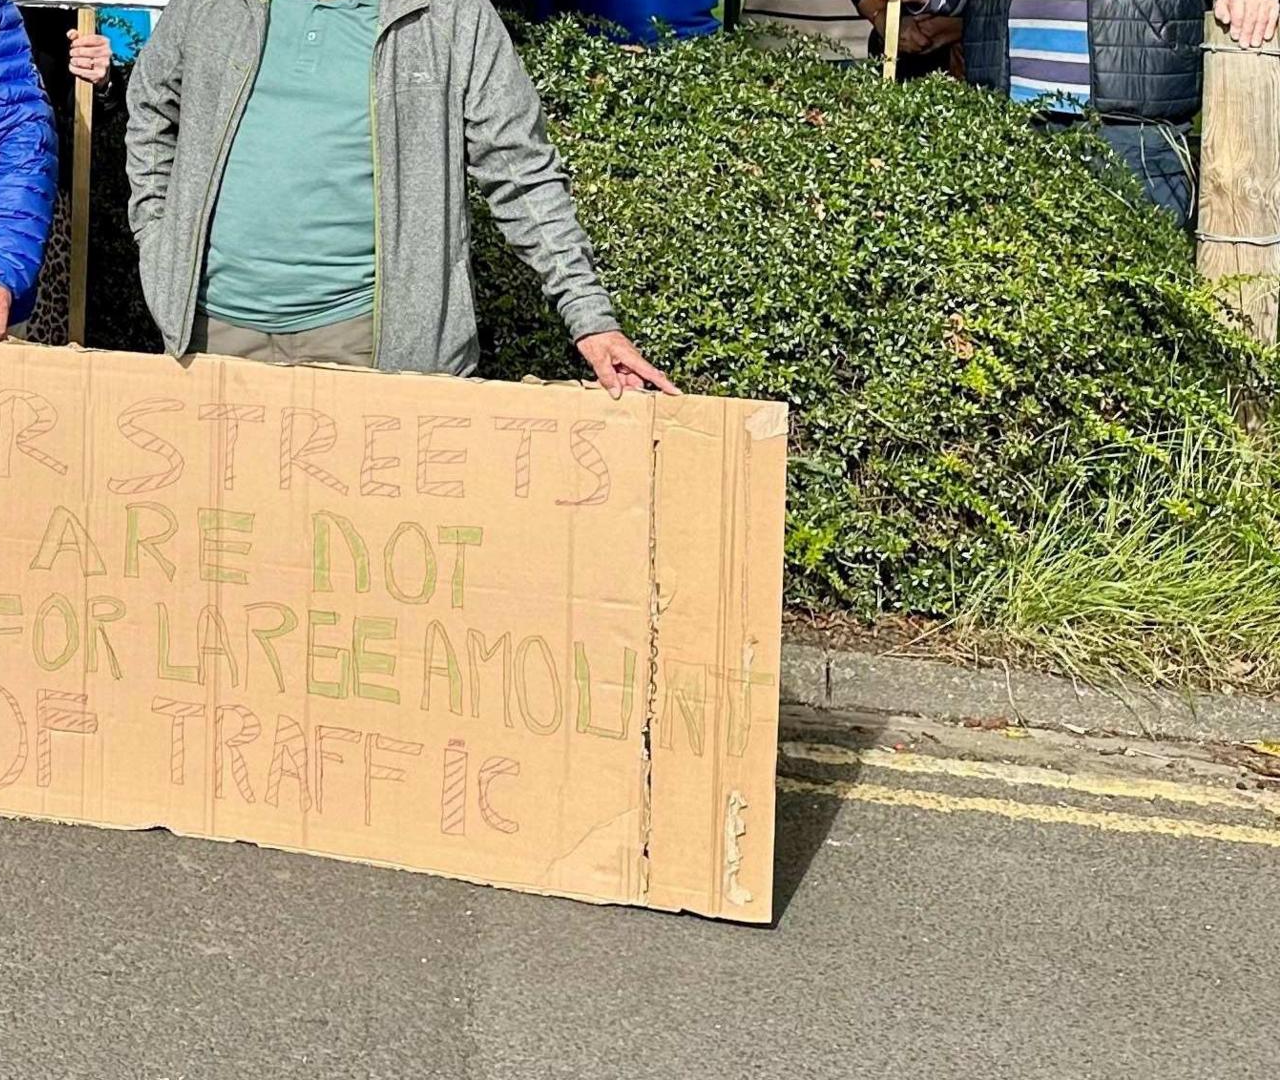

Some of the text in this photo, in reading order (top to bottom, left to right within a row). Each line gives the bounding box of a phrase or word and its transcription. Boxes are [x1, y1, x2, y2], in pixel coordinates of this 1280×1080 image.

[107, 398, 611, 506] STREETS
[28, 501, 483, 609] ARE NOT
[157, 601, 401, 706] LARGE
[420, 619, 775, 758] AMOUNT
[151, 696, 520, 836] TRAFFIC
